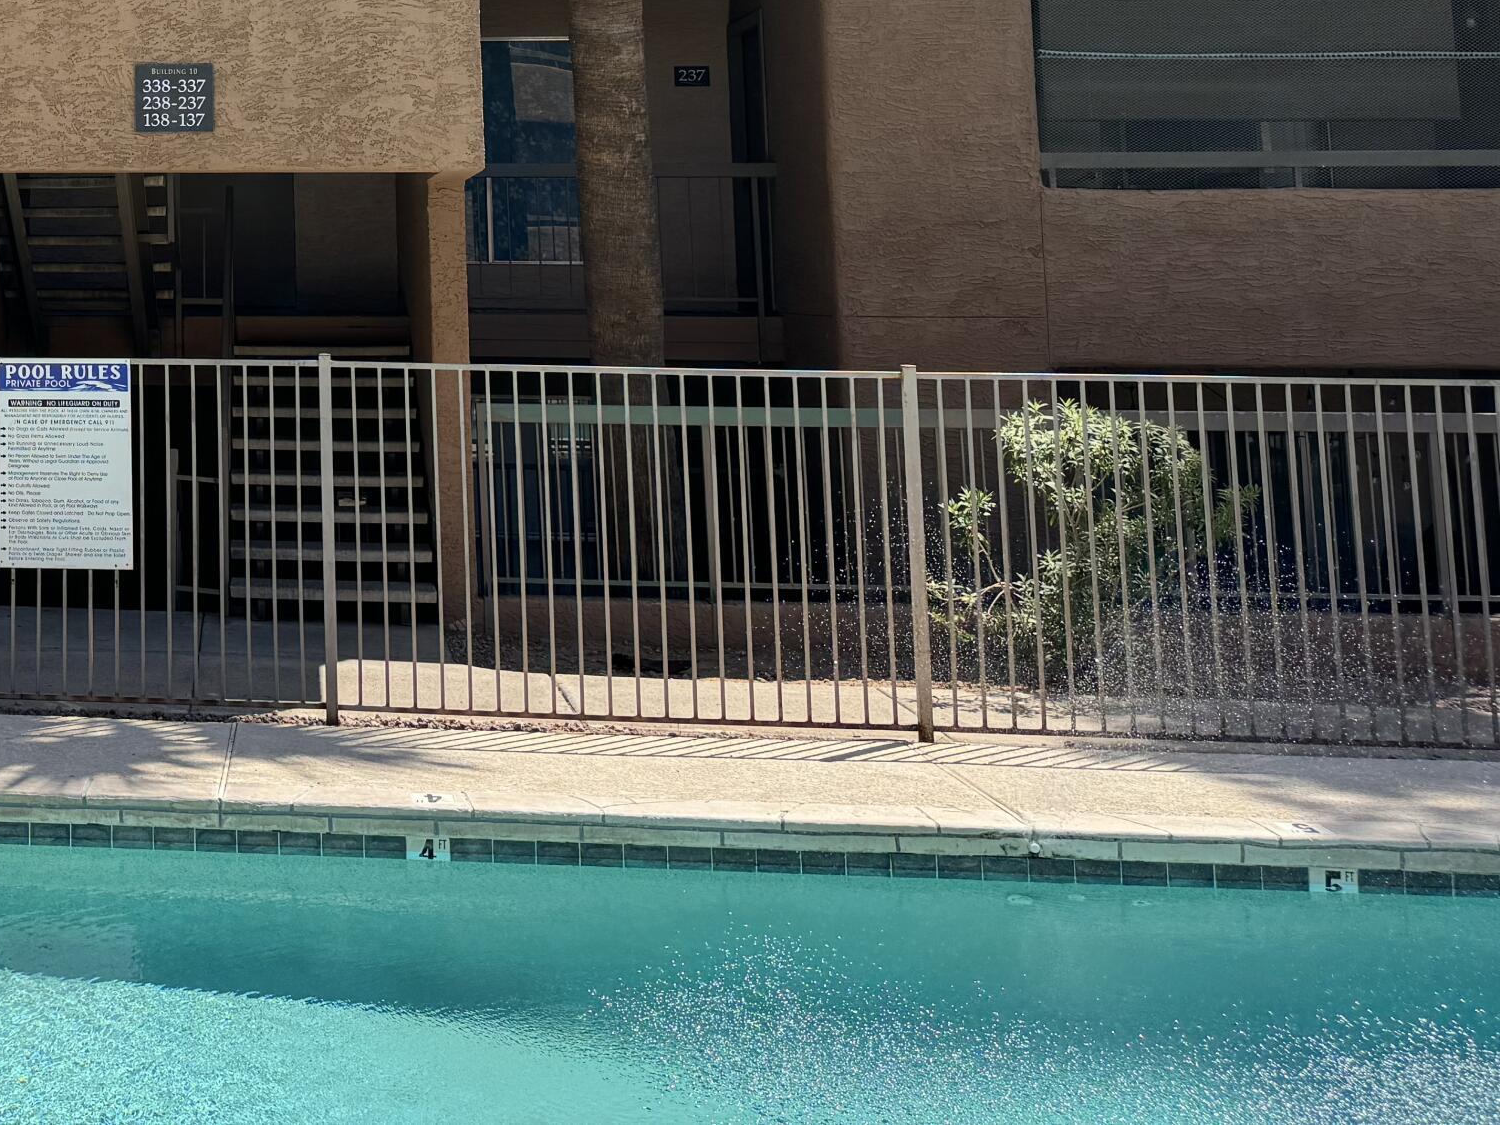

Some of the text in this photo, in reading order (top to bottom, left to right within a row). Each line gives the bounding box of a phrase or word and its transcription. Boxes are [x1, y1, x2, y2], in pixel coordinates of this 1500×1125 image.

[678, 69, 706, 82] 237
[142, 79, 206, 93] 338-337
[142, 96, 206, 110] 238-237
[143, 112, 206, 127] 138-137
[5, 364, 120, 380] POOL RULES
[44, 380, 71, 388] POOL
[418, 839, 447, 859] 4 FT
[1325, 870, 1354, 892] 5 FT
